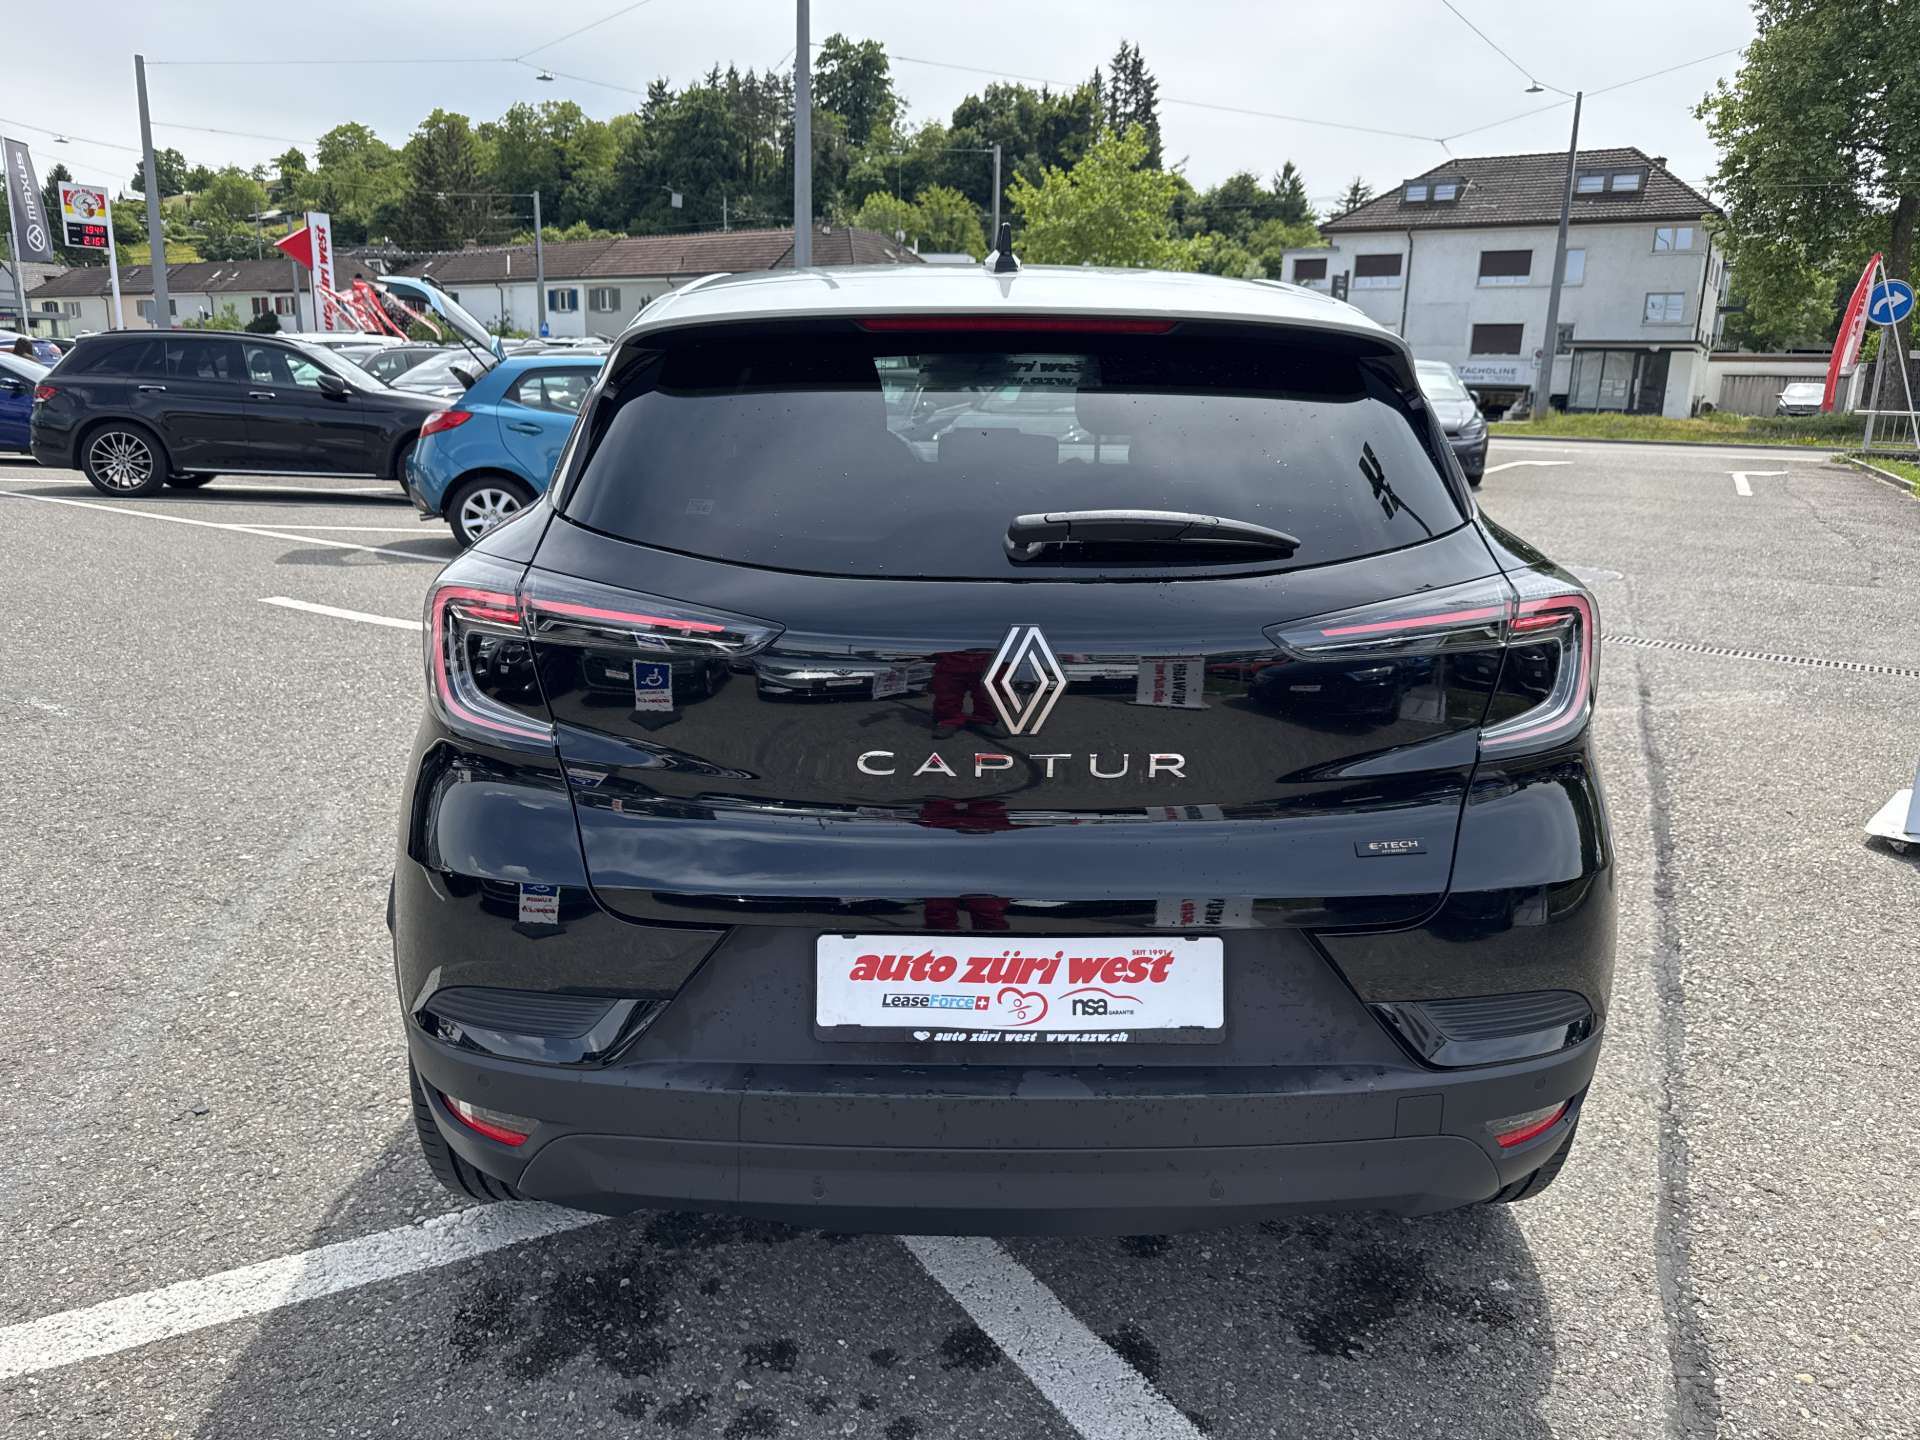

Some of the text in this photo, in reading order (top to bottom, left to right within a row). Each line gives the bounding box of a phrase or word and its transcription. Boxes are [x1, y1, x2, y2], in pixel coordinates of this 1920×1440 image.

[16, 151, 37, 220] MAXUS
[315, 224, 329, 264] west
[1458, 366, 1517, 376] TACHOLINE
[857, 750, 1187, 779] CAPTUR
[1368, 840, 1418, 850] E-TECH
[849, 949, 1175, 985] auto züri west
[882, 993, 975, 1009] LeaseForce
[1072, 998, 1108, 1016] nsa
[933, 1031, 1129, 1043] auto züri west www.azw.ch
